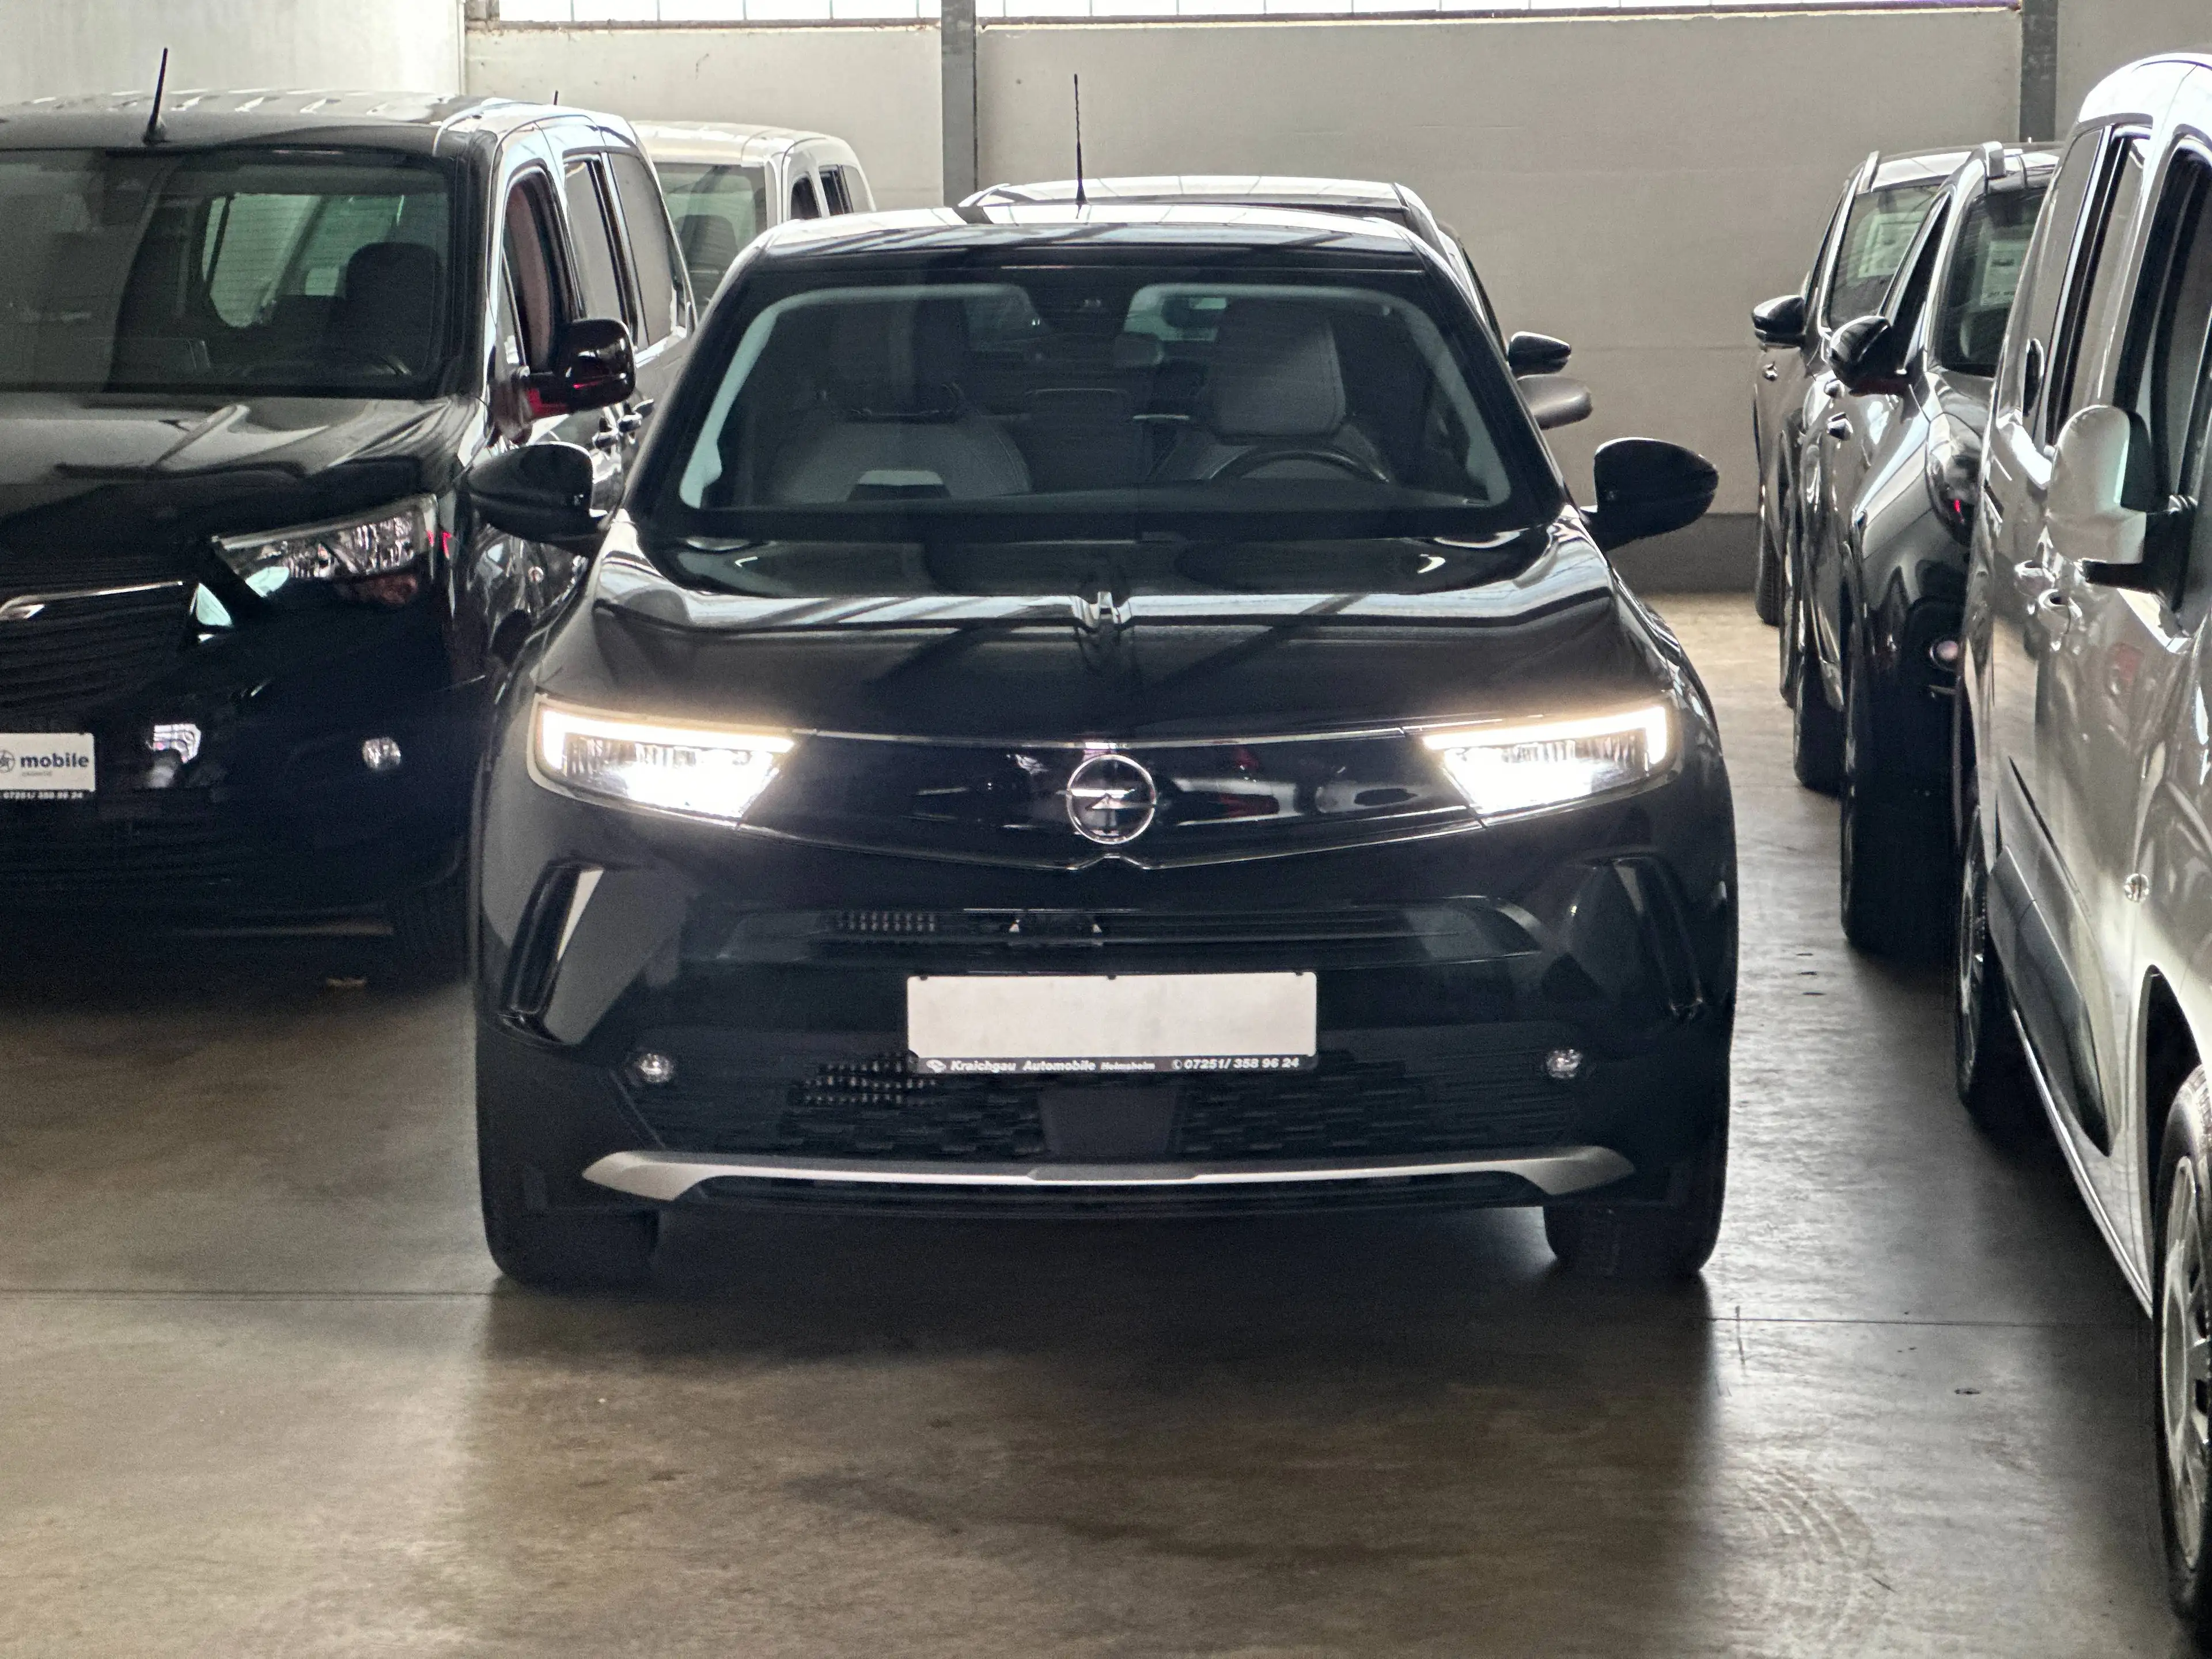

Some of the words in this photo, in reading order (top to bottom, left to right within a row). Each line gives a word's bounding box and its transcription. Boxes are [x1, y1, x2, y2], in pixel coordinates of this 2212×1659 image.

[21, 752, 89, 767] mobile
[950, 1060, 1017, 1073] Kraichgau
[1022, 1059, 1097, 1071] Automobile
[1282, 1057, 1300, 1067] 24
